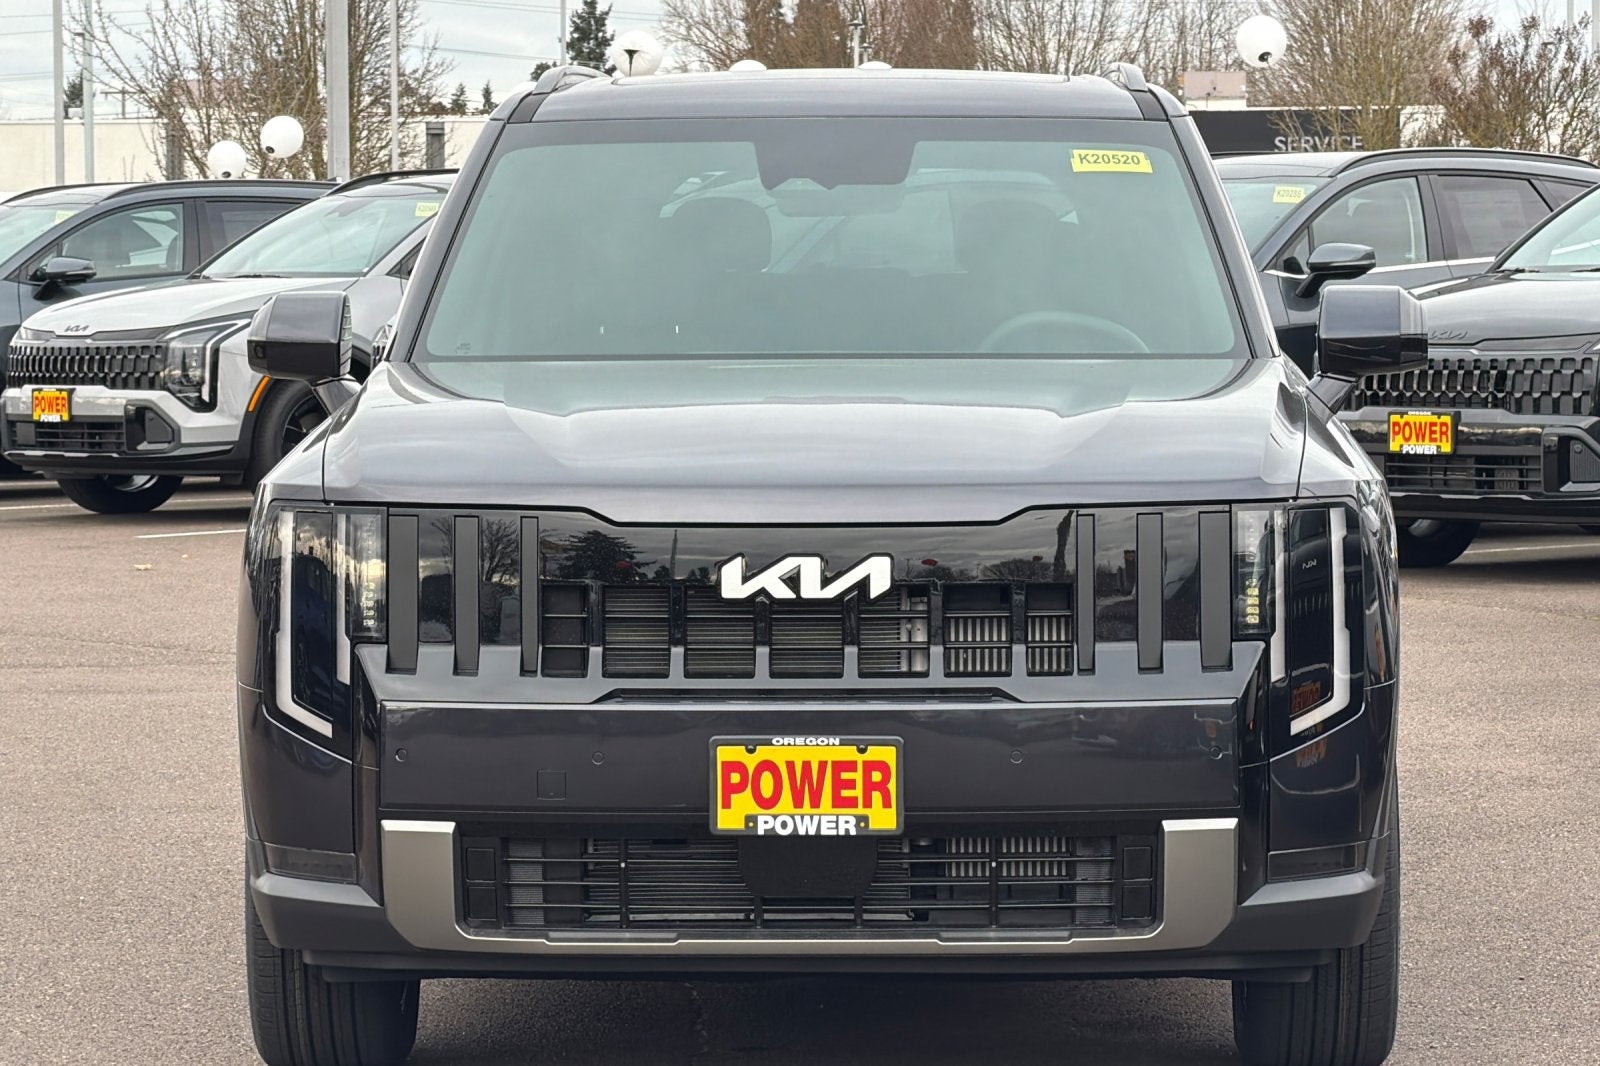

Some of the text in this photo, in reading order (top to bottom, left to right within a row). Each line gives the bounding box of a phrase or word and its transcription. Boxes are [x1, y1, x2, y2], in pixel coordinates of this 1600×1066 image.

[1078, 153, 1141, 165] K20520
[34, 396, 67, 413] POWER
[1392, 421, 1449, 443] POWER
[1402, 445, 1437, 454] POWER
[721, 556, 892, 600] KIA
[772, 737, 840, 745] OREGON
[721, 759, 892, 810] POWER
[757, 815, 857, 836] POWER
